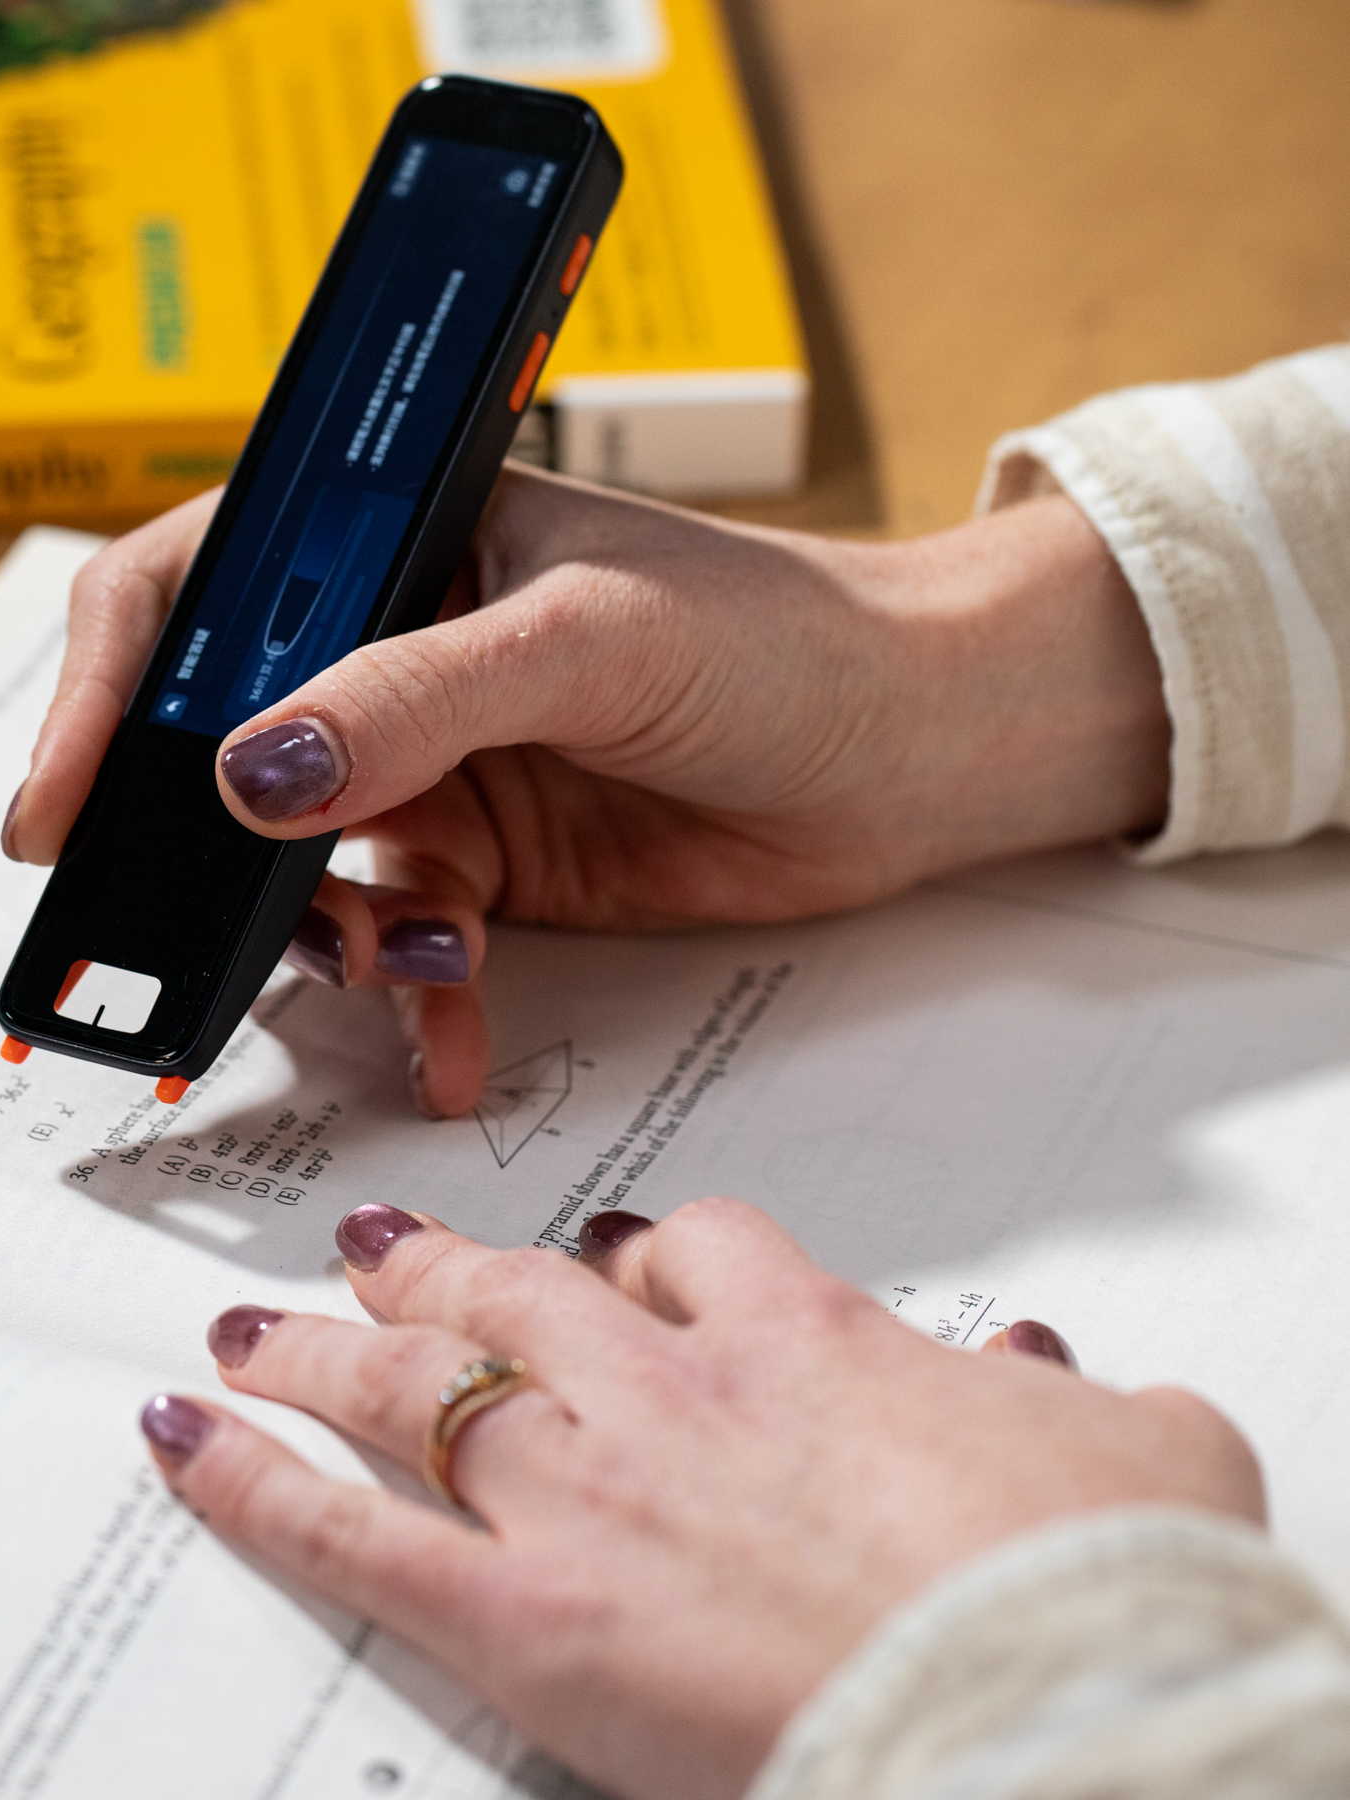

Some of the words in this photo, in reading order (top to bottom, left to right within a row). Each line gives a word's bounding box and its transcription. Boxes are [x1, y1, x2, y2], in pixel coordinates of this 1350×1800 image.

[666, 1067, 726, 1119] following
[27, 1123, 59, 1141] (E)
[118, 1146, 147, 1165] the
[140, 1109, 182, 1147] surface
[175, 1089, 202, 1110] area
[655, 1119, 681, 1138] the
[69, 1164, 99, 1183] 36.
[91, 1147, 112, 1159] A
[104, 1111, 144, 1146] sphere
[647, 1134, 668, 1151] of
[157, 1155, 191, 1176] (A)
[539, 1194, 584, 1244] pyramid
[572, 1162, 612, 1197] shown
[597, 1143, 628, 1162] has
[626, 1101, 662, 1135] square
[646, 1074, 680, 1099] base
[621, 1150, 658, 1183] which
[186, 1164, 219, 1183] (B)
[215, 1170, 249, 1191] (C)
[245, 1177, 279, 1198] (D)
[274, 1187, 307, 1206] (E)
[598, 1182, 632, 1209] then
[893, 1285, 917, 1296] h
[958, 1292, 983, 1310] 4h
[989, 1321, 1009, 1331] 3
